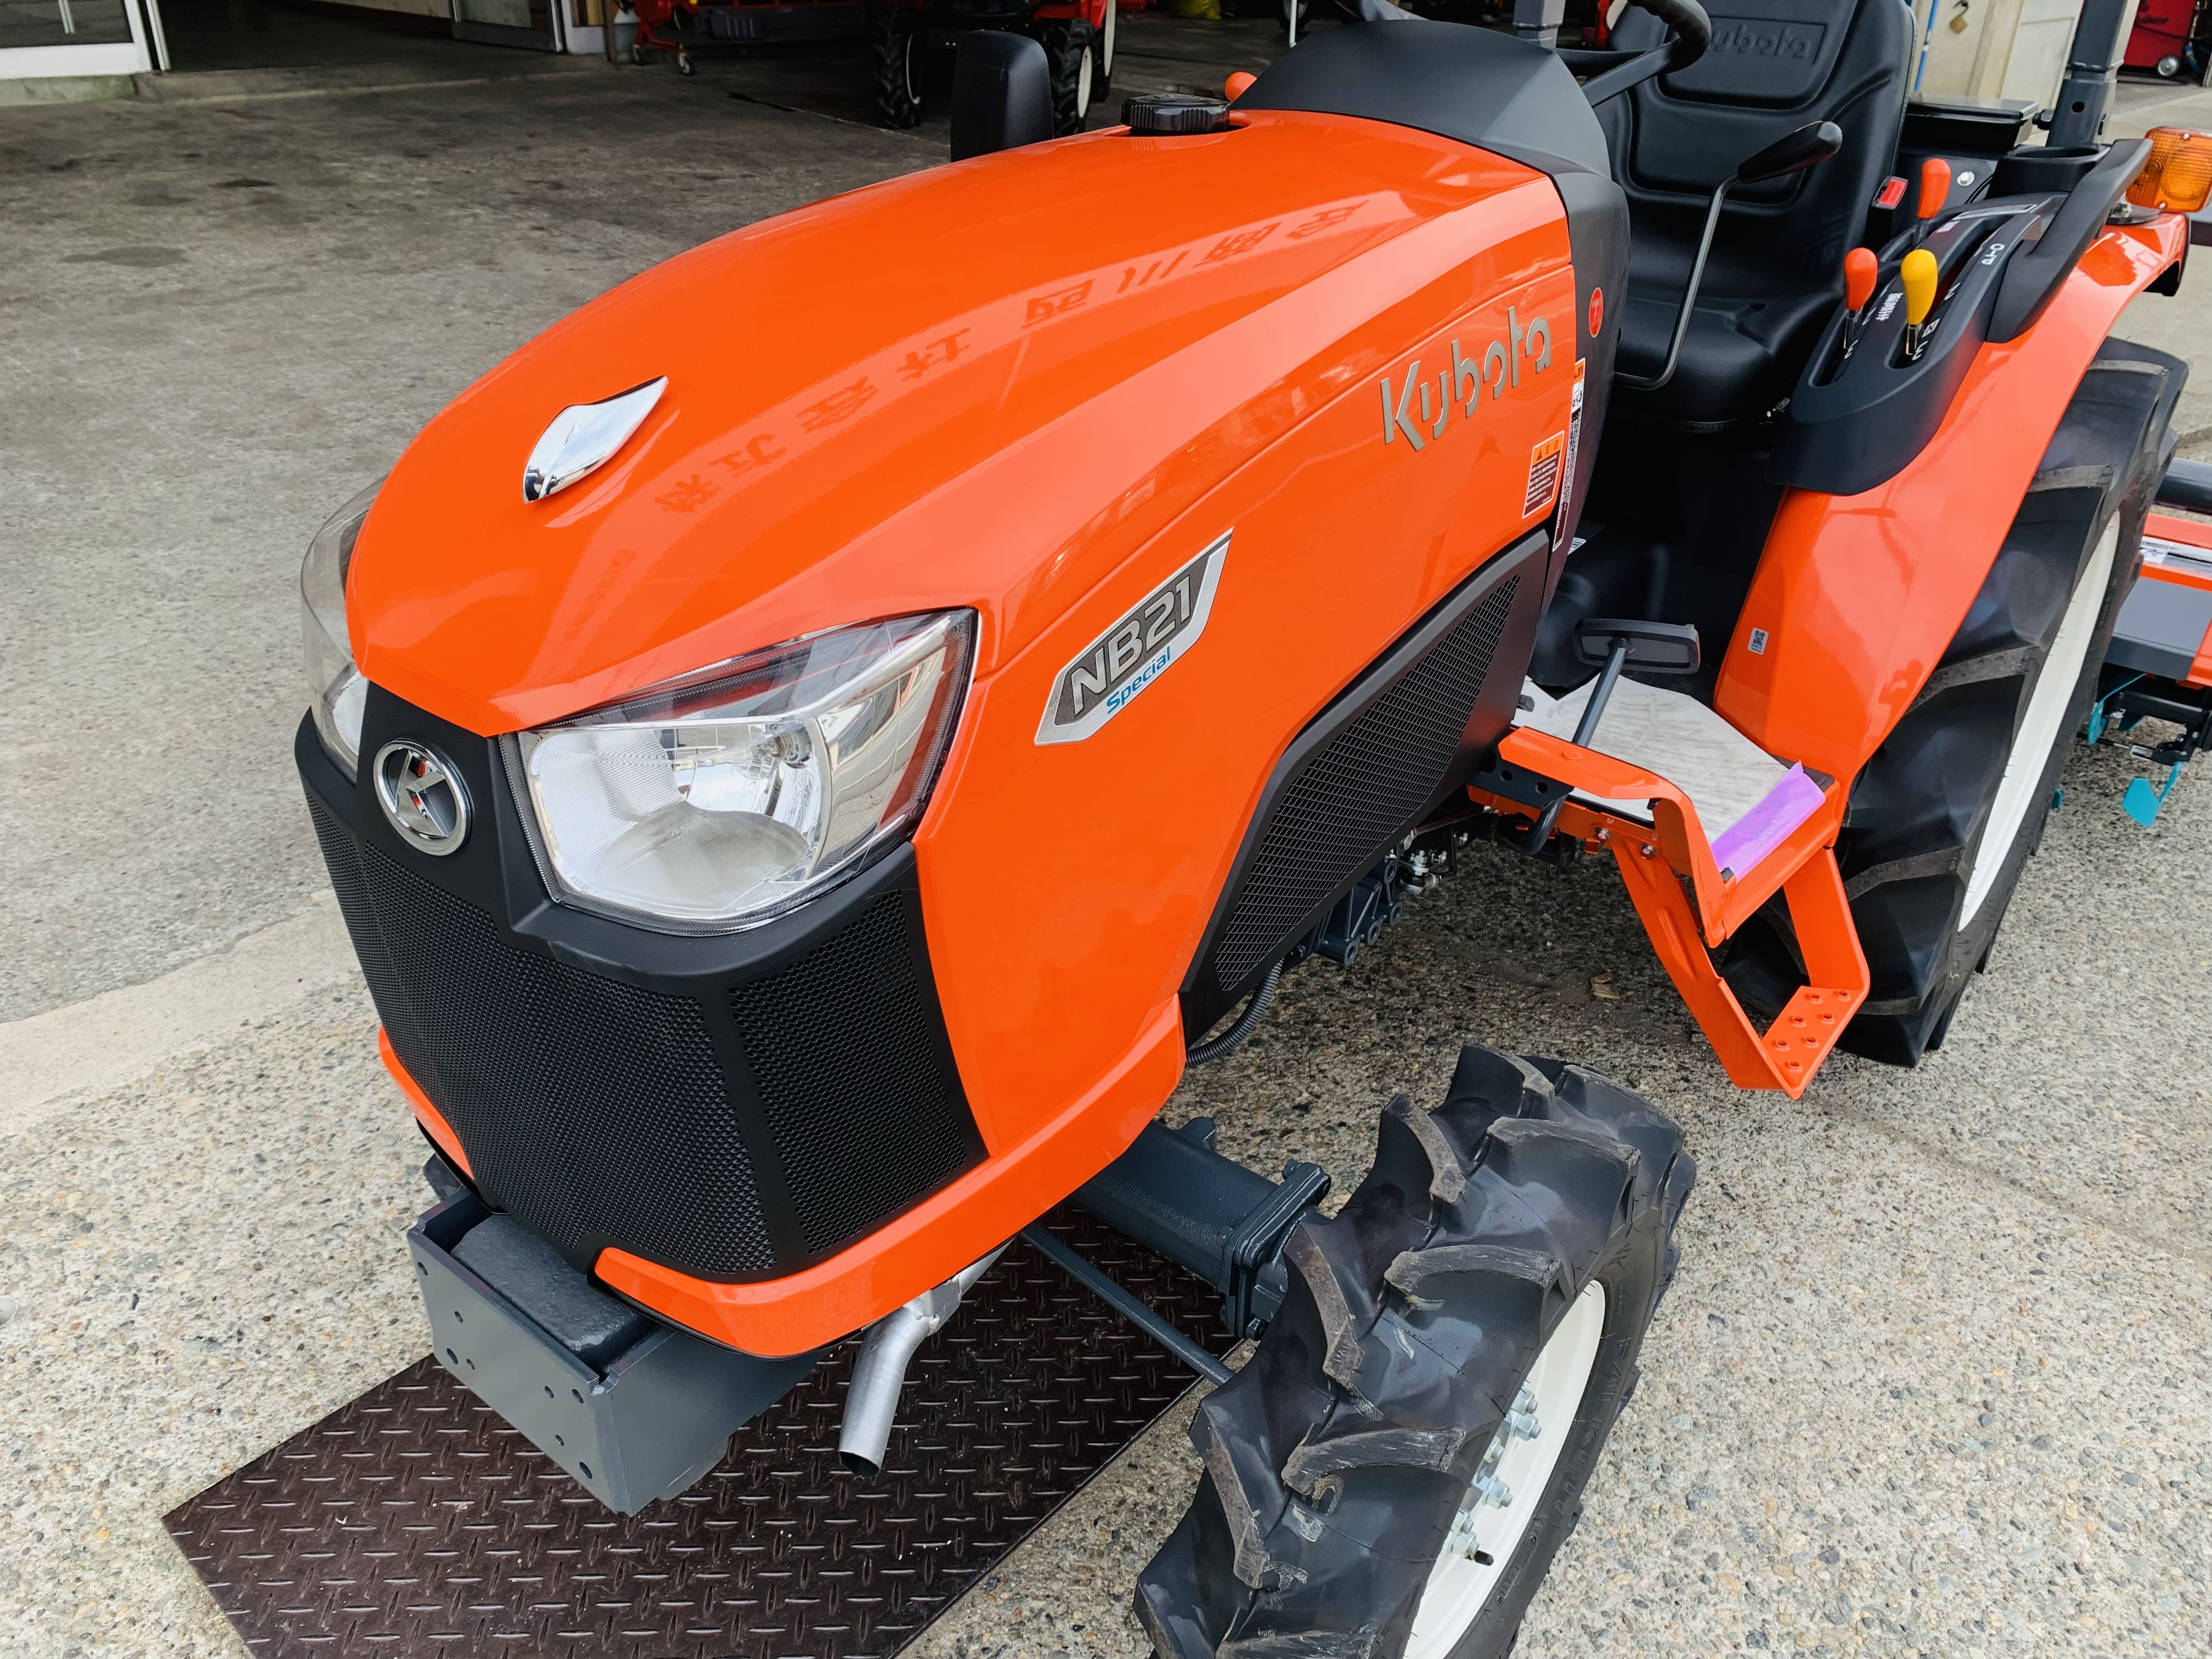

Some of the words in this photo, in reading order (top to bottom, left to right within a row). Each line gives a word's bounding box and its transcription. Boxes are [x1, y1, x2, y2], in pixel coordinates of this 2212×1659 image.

[1709, 25, 1812, 58] ubota
[1981, 243, 2005, 266] PTO
[1380, 306, 1551, 452] Kubota
[1070, 574, 1193, 718] NB21
[1106, 646, 1171, 716] Special
